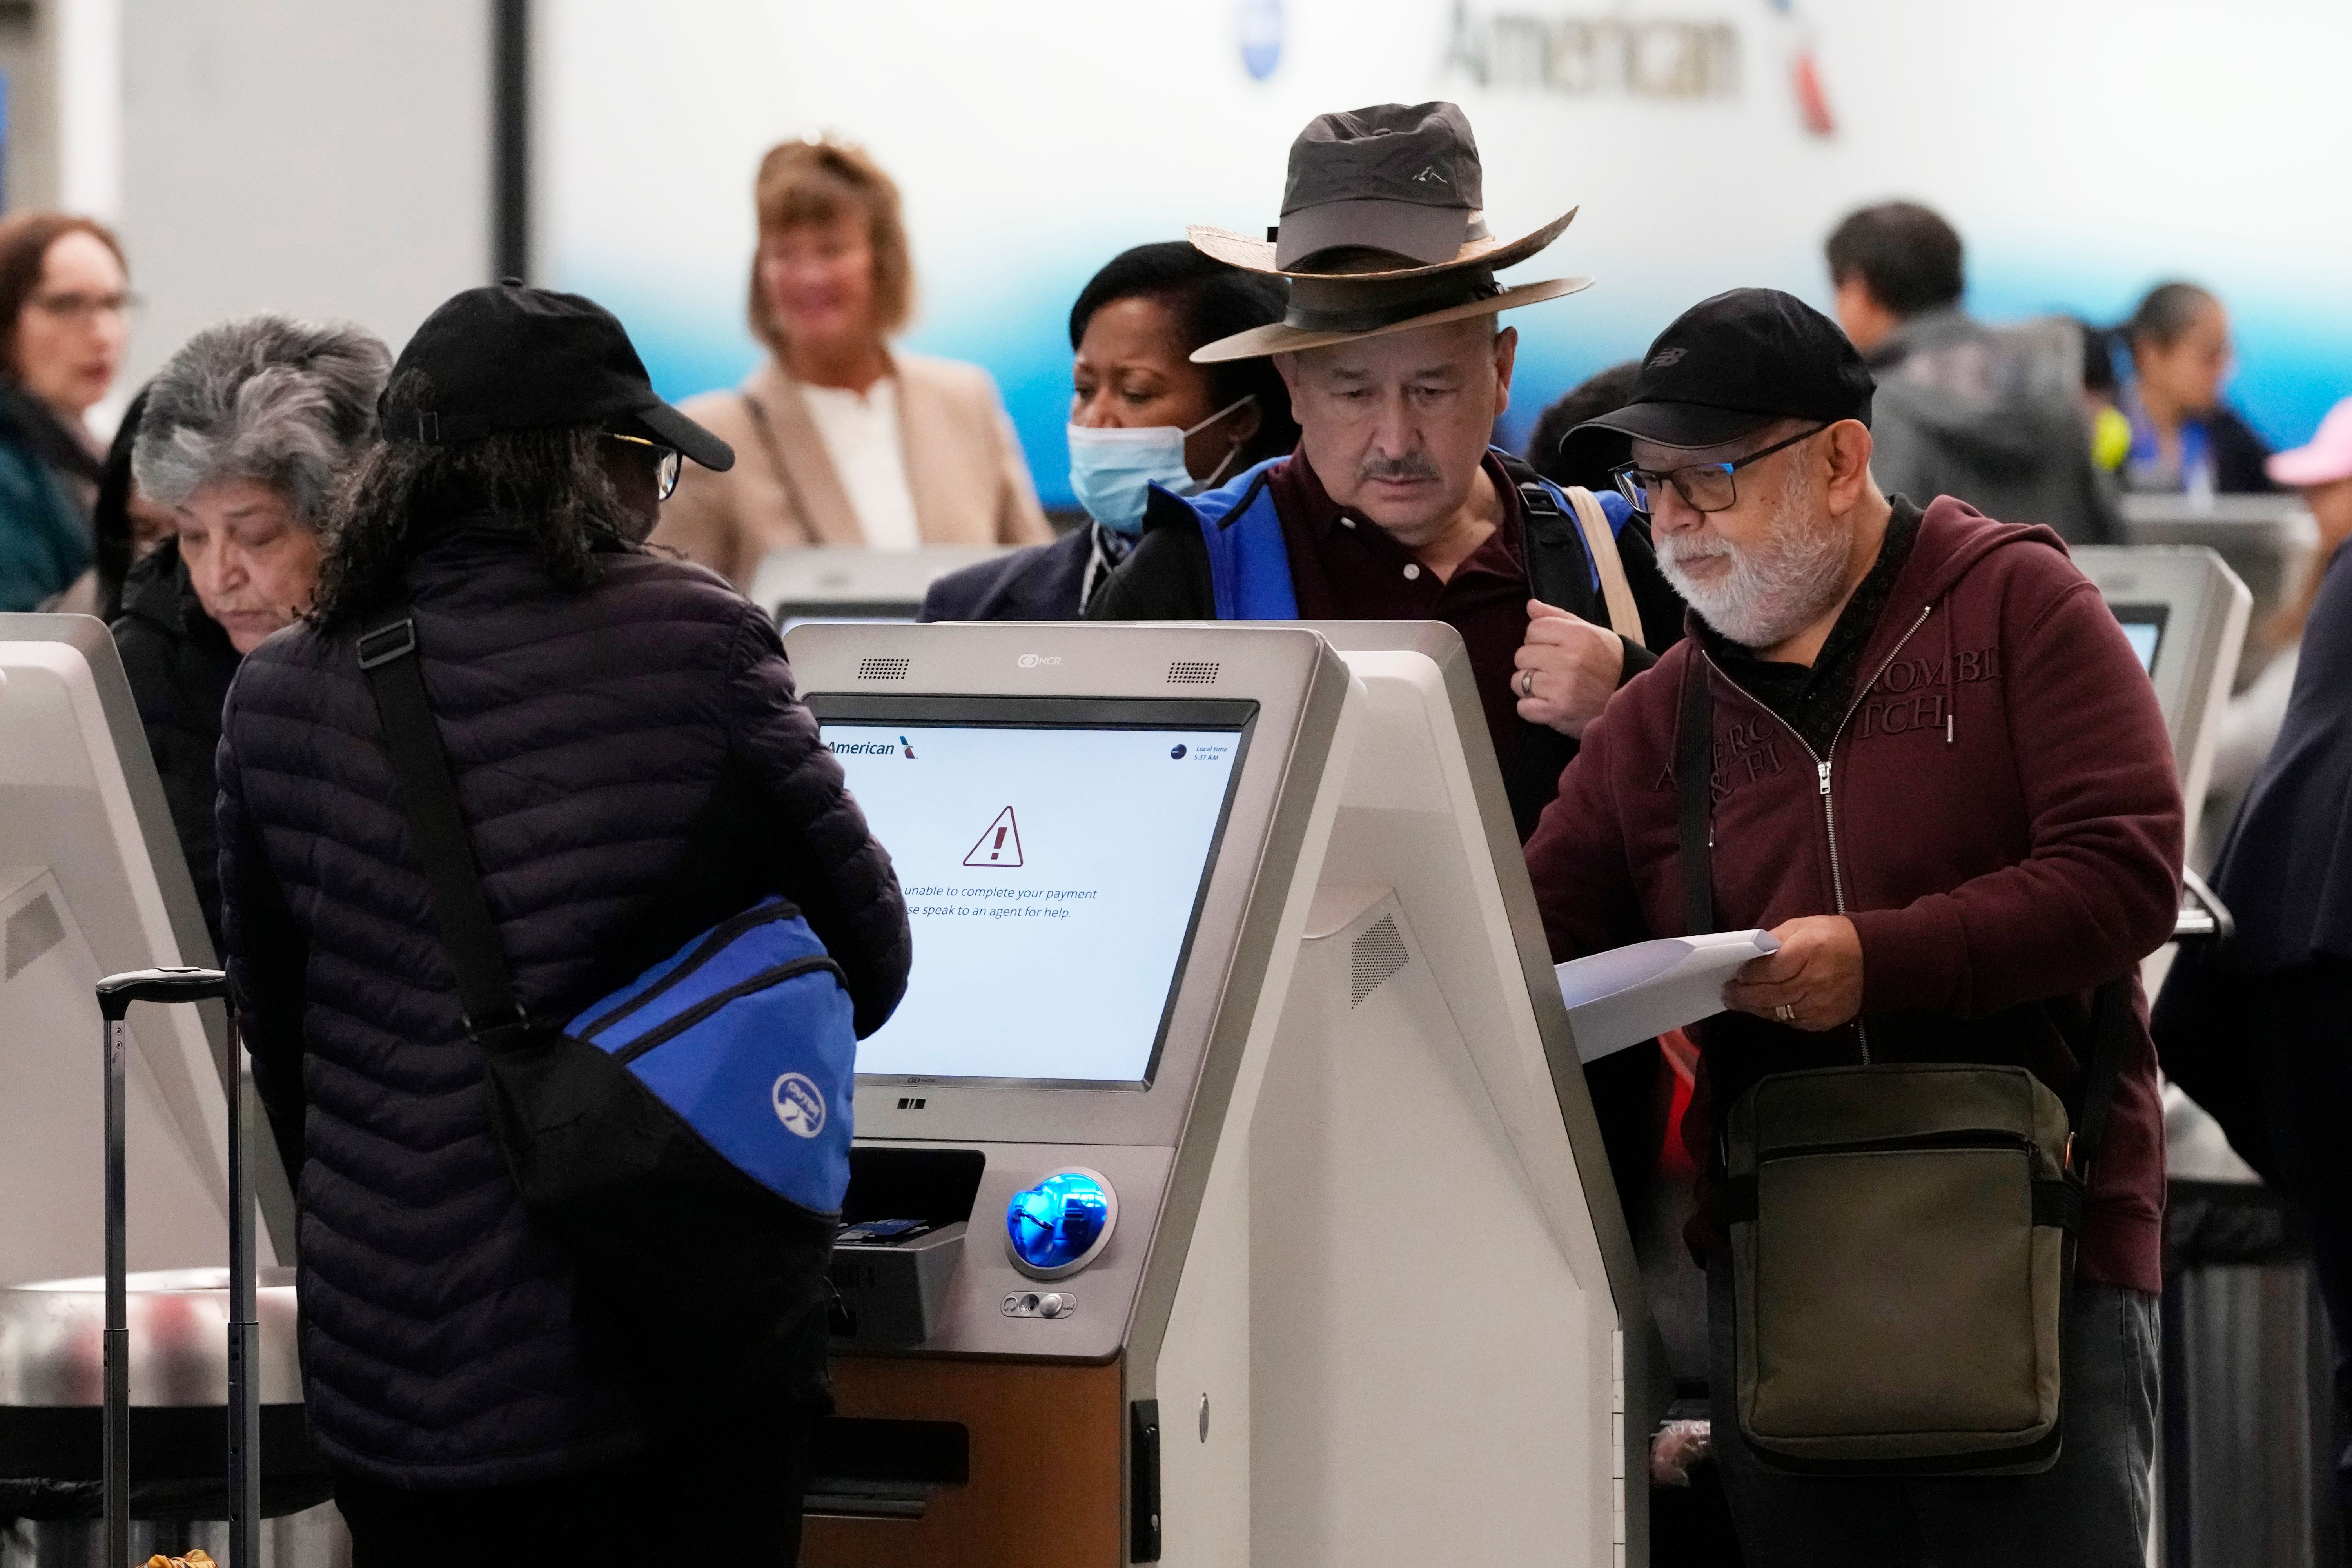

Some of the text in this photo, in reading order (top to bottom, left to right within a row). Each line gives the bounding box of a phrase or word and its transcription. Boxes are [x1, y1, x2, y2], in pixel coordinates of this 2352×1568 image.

[828, 741, 895, 755] American
[904, 885, 1099, 901] unable to complete your payment.
[922, 905, 955, 917] speak
[958, 906, 969, 915] to
[989, 907, 1022, 919] agent
[1024, 906, 1042, 917] for
[1044, 907, 1071, 920] help.
